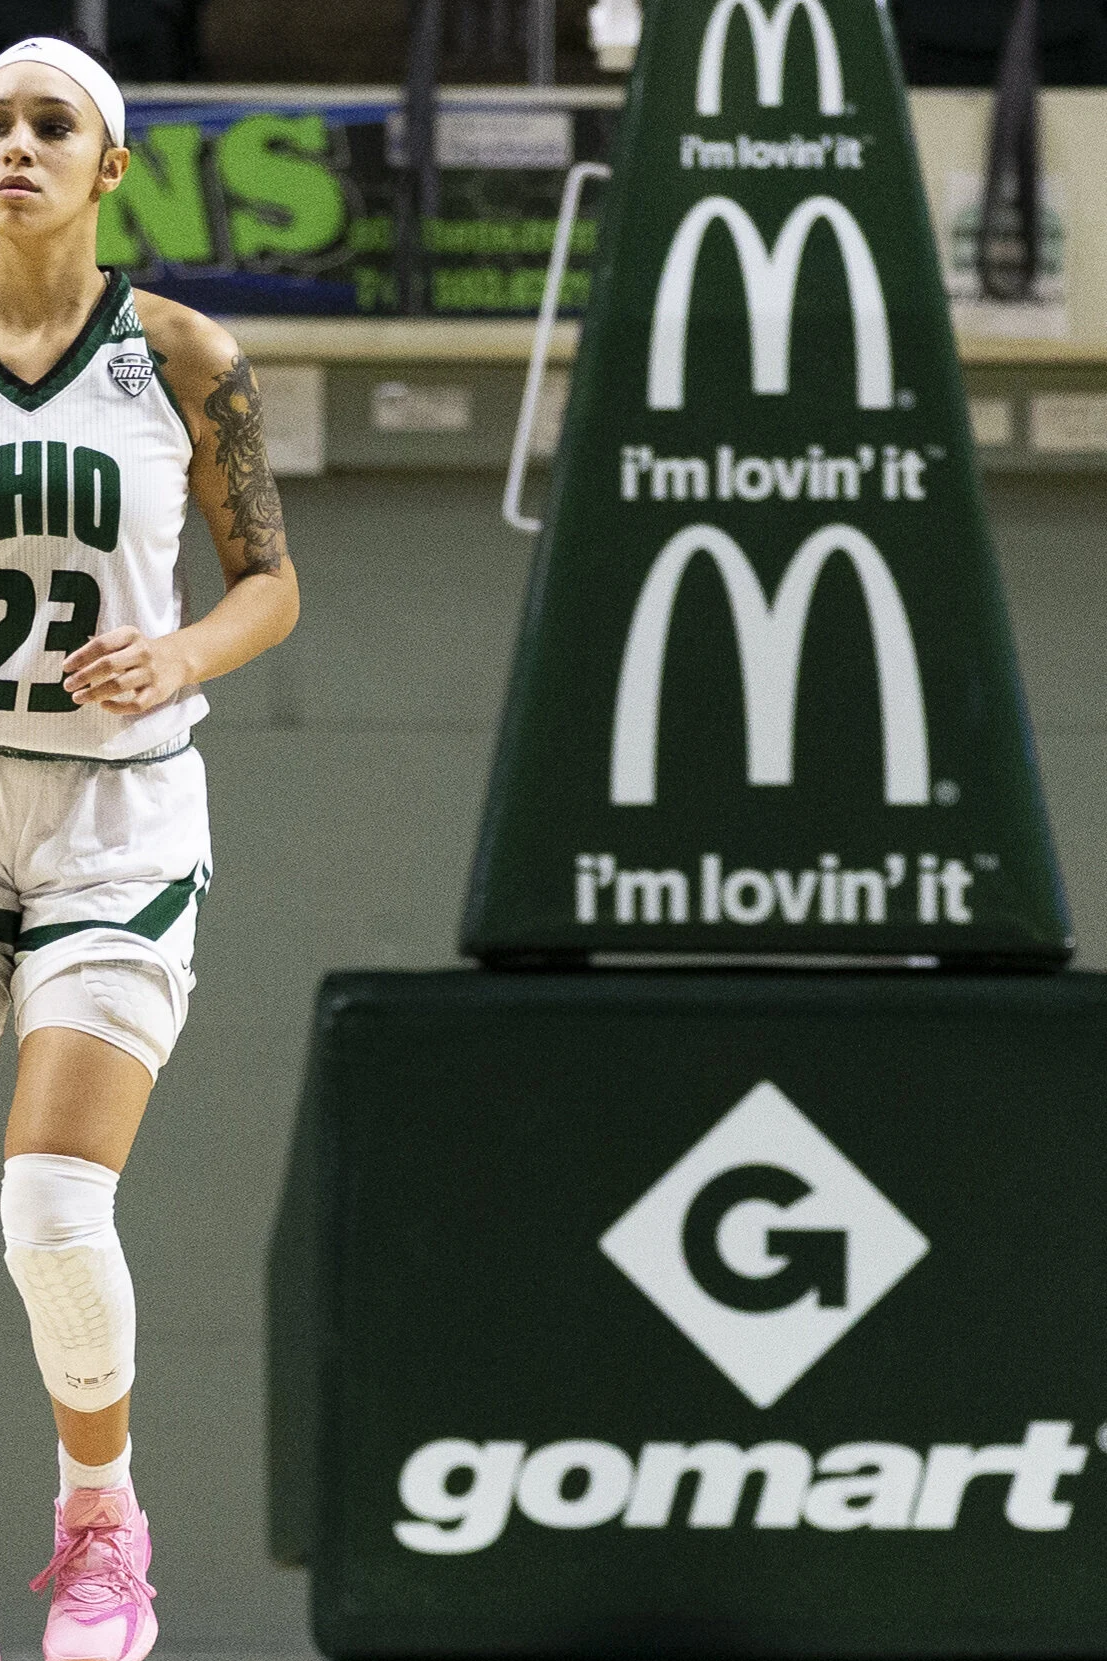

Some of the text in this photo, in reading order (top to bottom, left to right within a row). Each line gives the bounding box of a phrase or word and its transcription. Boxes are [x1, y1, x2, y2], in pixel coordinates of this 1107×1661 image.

[112, 366, 152, 378] MAC
[621, 444, 927, 501] i'm lovin' it
[575, 853, 974, 924] i'm lovin' it
[393, 1420, 1089, 1555] gomart
